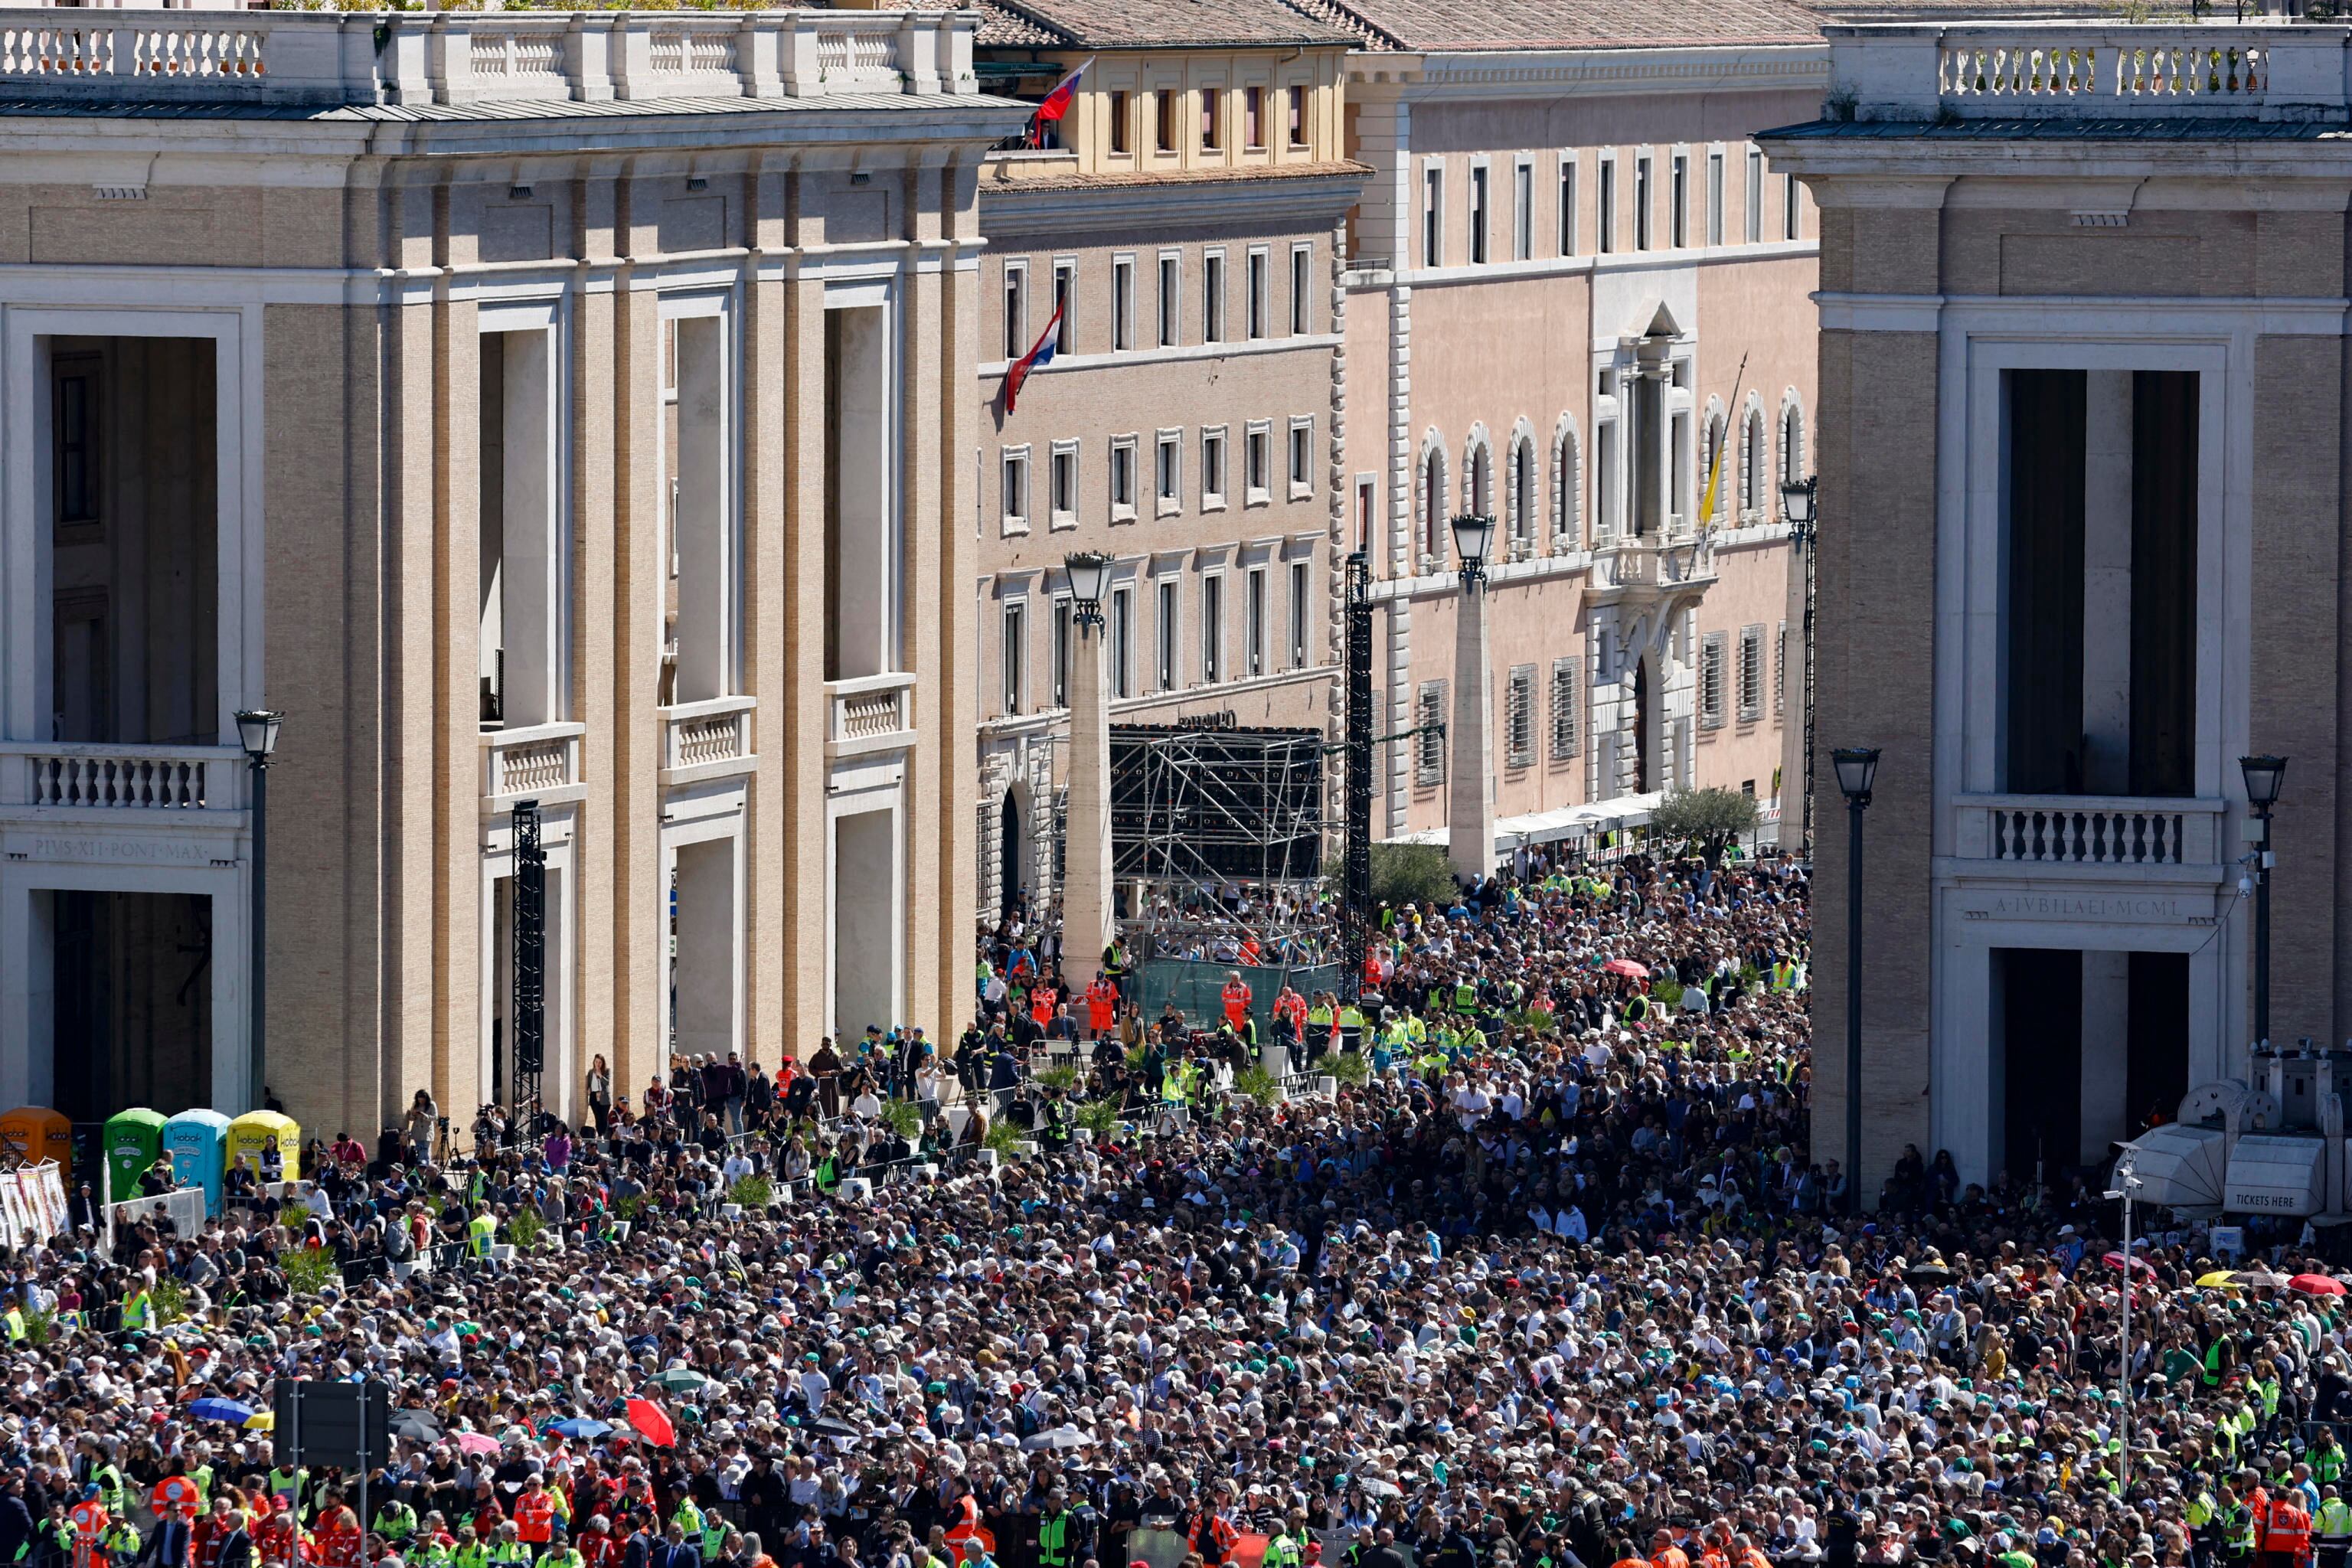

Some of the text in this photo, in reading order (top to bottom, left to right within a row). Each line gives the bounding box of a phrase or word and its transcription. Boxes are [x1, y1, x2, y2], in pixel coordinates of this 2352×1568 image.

[173, 1132, 202, 1142] kobak
[237, 1134, 265, 1145] kobak
[2236, 1194, 2295, 1207] TICKETS HERE
